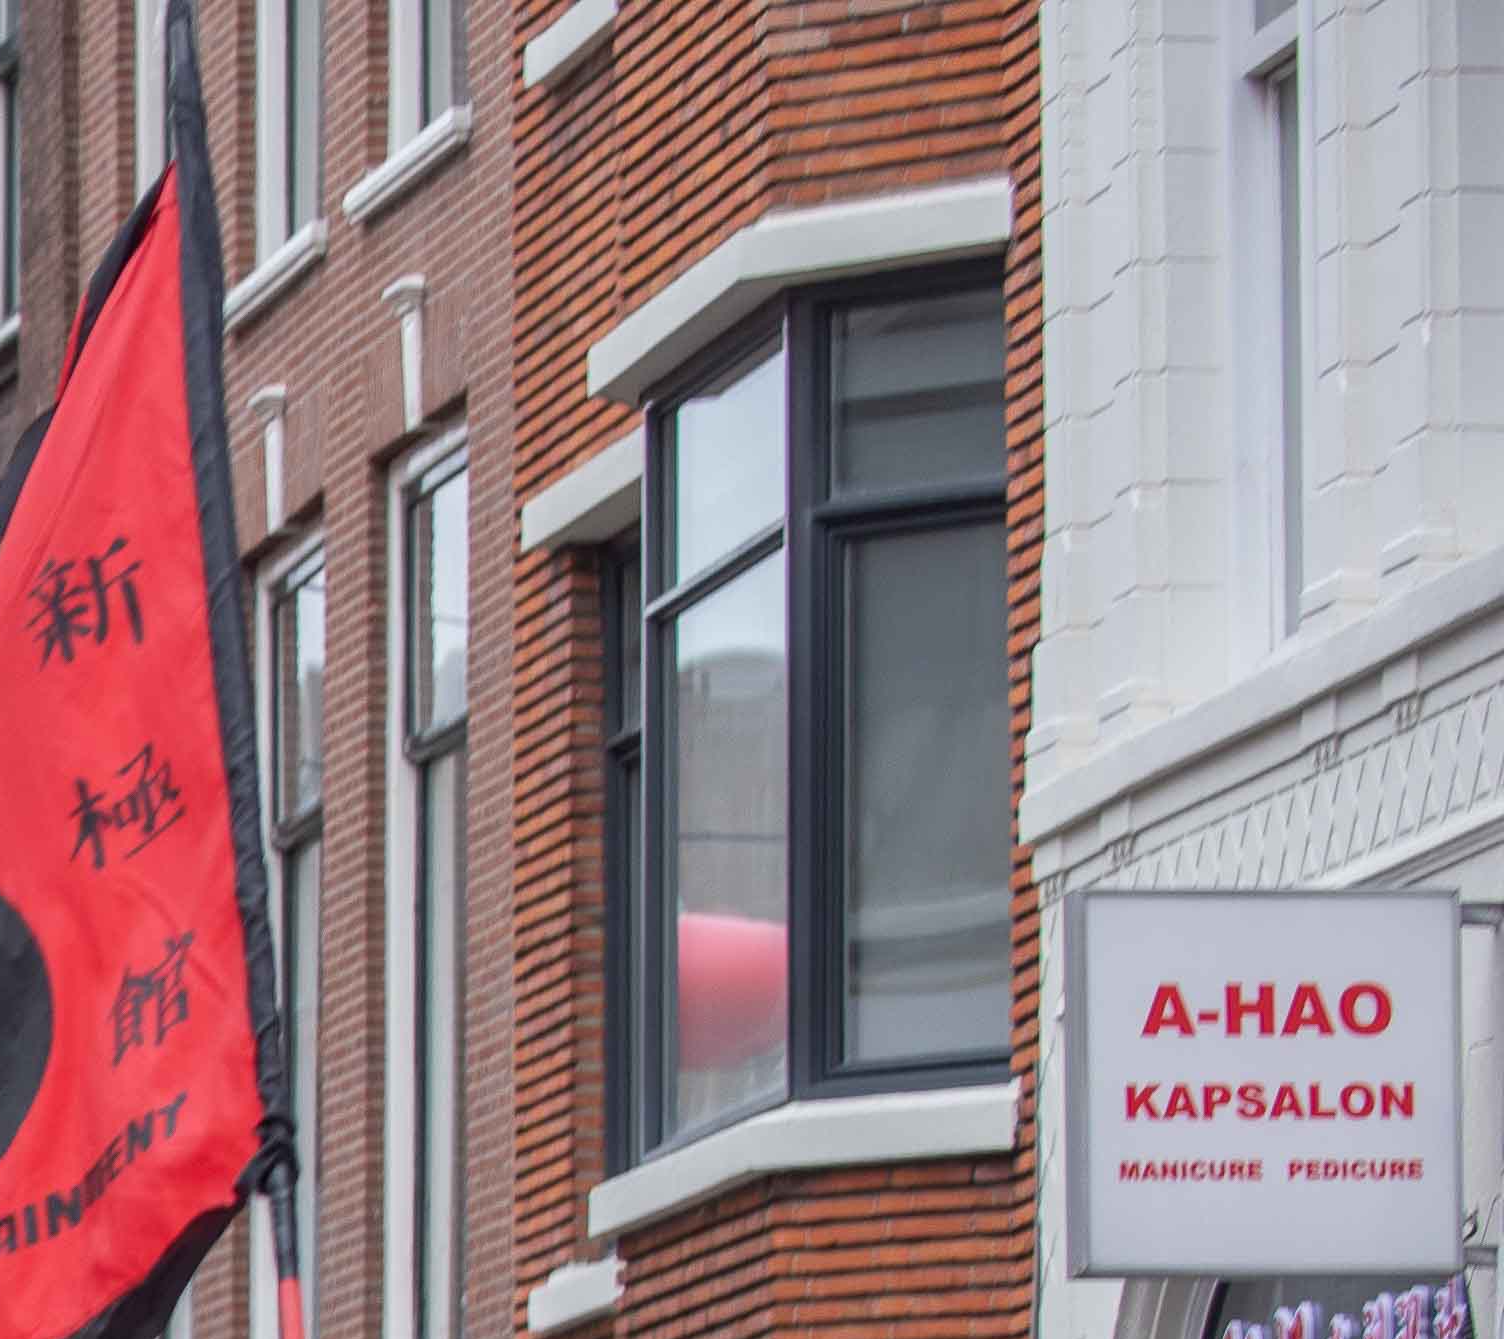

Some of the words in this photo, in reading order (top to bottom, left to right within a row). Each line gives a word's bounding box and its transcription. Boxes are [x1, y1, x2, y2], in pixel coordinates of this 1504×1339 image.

[1141, 982, 1393, 1038] A-HAO
[1123, 1082, 1415, 1121] KAPSALON
[1118, 1158, 1264, 1184] MANICURE
[1287, 1157, 1426, 1183] PEDICURE
